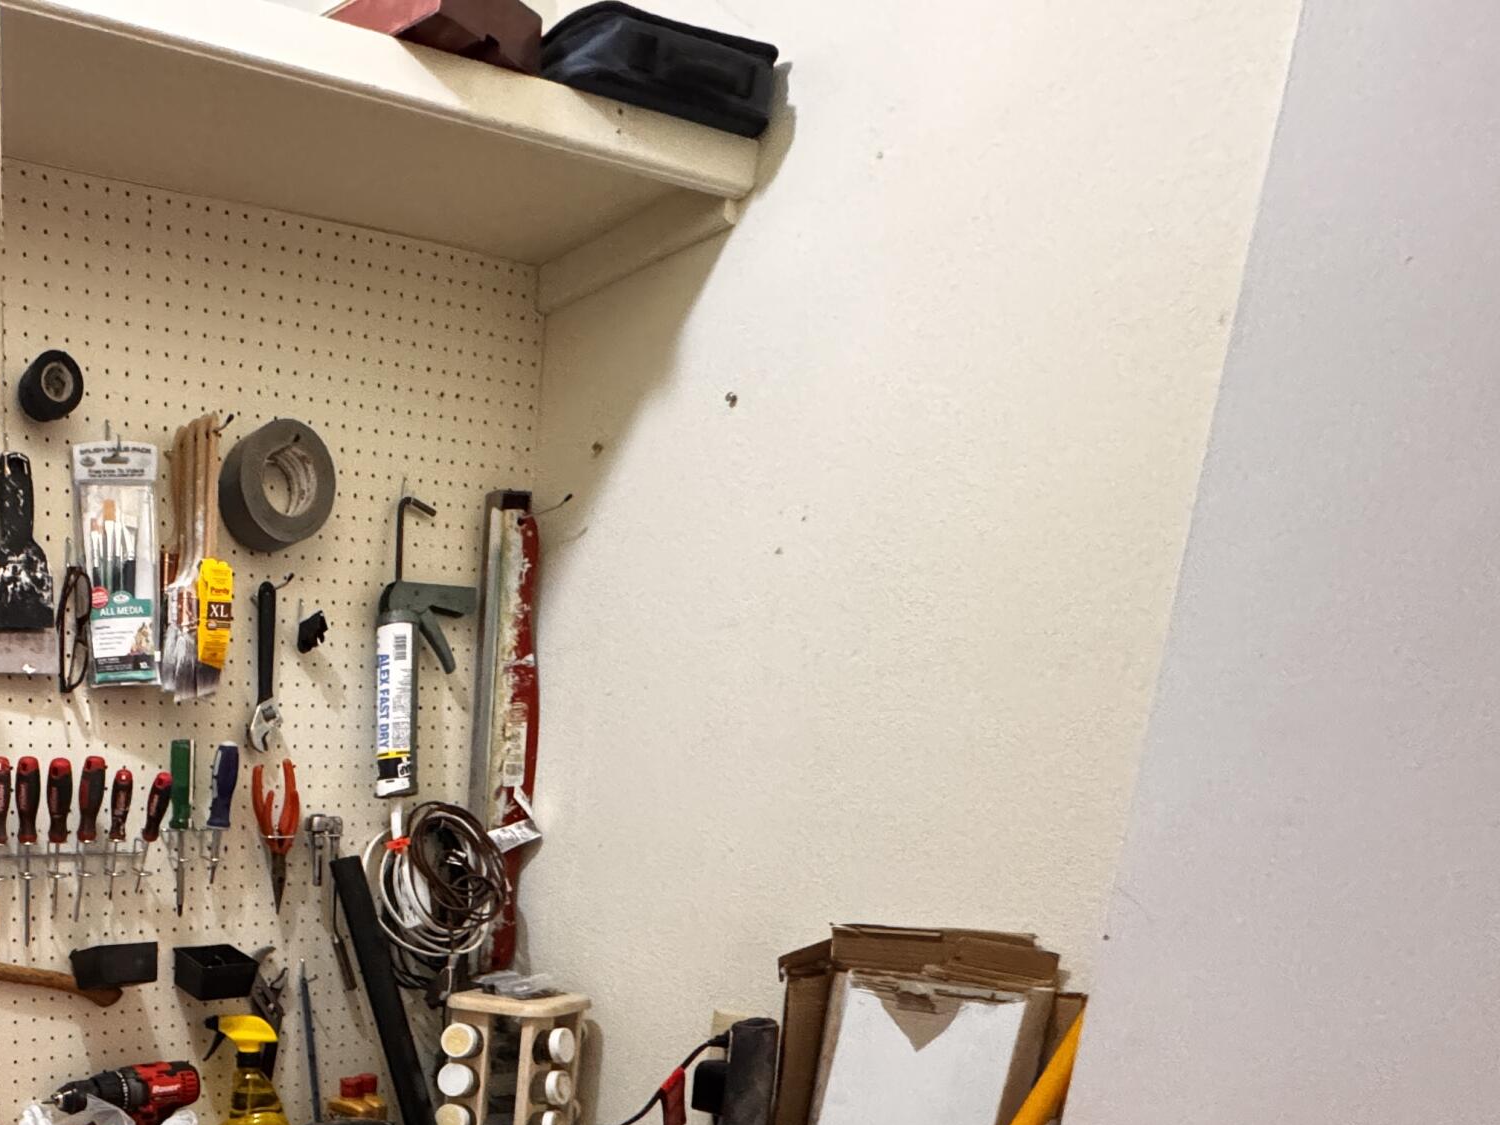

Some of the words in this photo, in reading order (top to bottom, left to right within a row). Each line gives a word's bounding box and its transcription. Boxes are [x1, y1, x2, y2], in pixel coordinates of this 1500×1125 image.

[210, 586, 230, 596] Purdy
[100, 606, 116, 617] ALL
[117, 605, 144, 616] MEDIA
[209, 604, 230, 618] XL
[377, 653, 390, 685] ALEX
[377, 689, 390, 721] FAST
[377, 723, 390, 749] DRY
